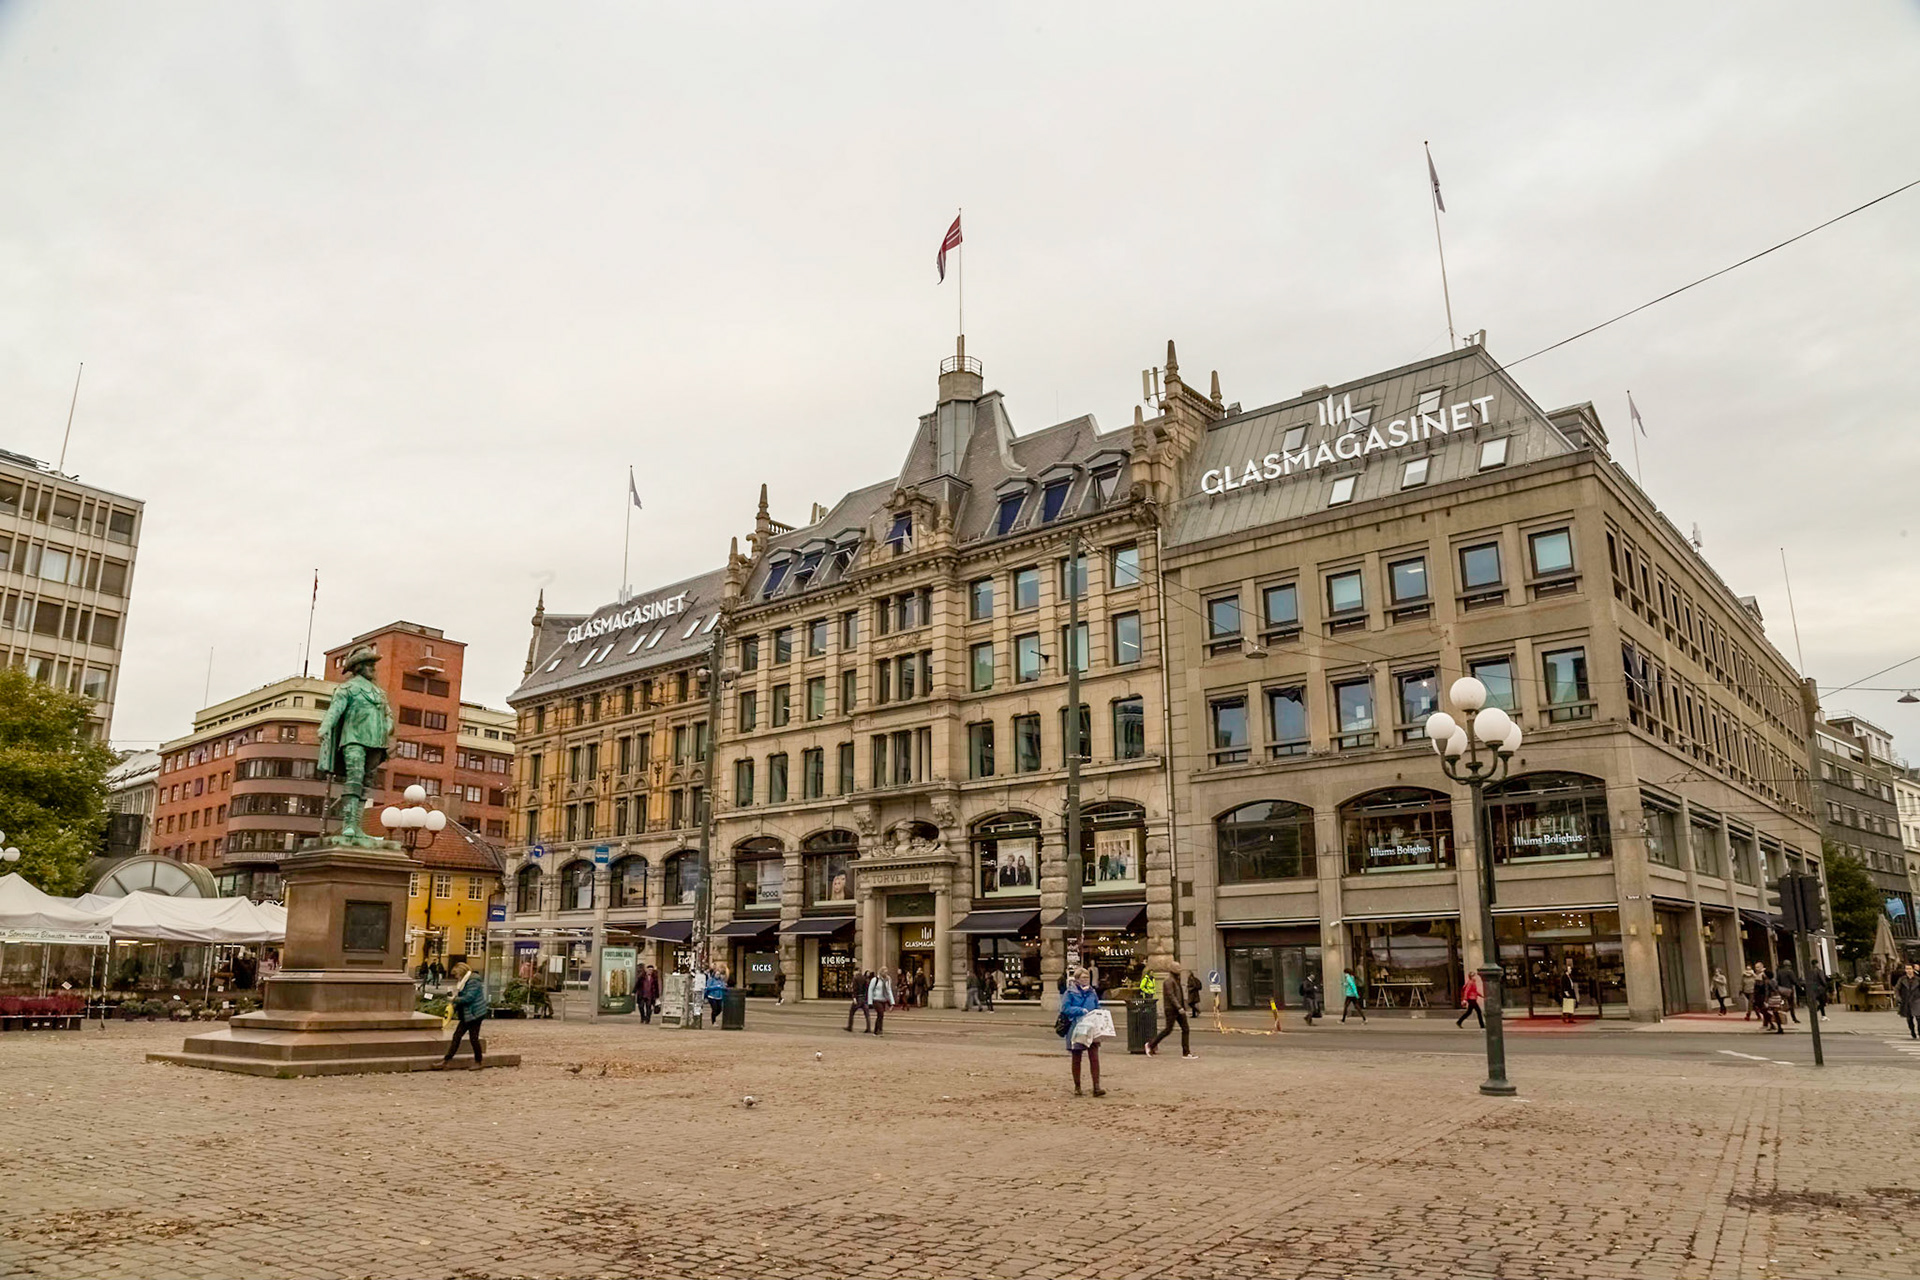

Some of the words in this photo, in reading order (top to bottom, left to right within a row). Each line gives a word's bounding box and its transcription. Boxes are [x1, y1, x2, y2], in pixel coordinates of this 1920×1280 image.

[1200, 394, 1495, 495] GLASMAGASINET
[567, 593, 688, 644] GLASMAGASINET
[1513, 836, 1542, 846] Illums
[1543, 833, 1583, 845] Bolighus
[1370, 848, 1396, 857] Illums
[1396, 844, 1432, 855] Bolighus
[871, 873, 907, 884] TORVET
[821, 956, 846, 965] KICKS
[752, 964, 772, 972] KICKS
